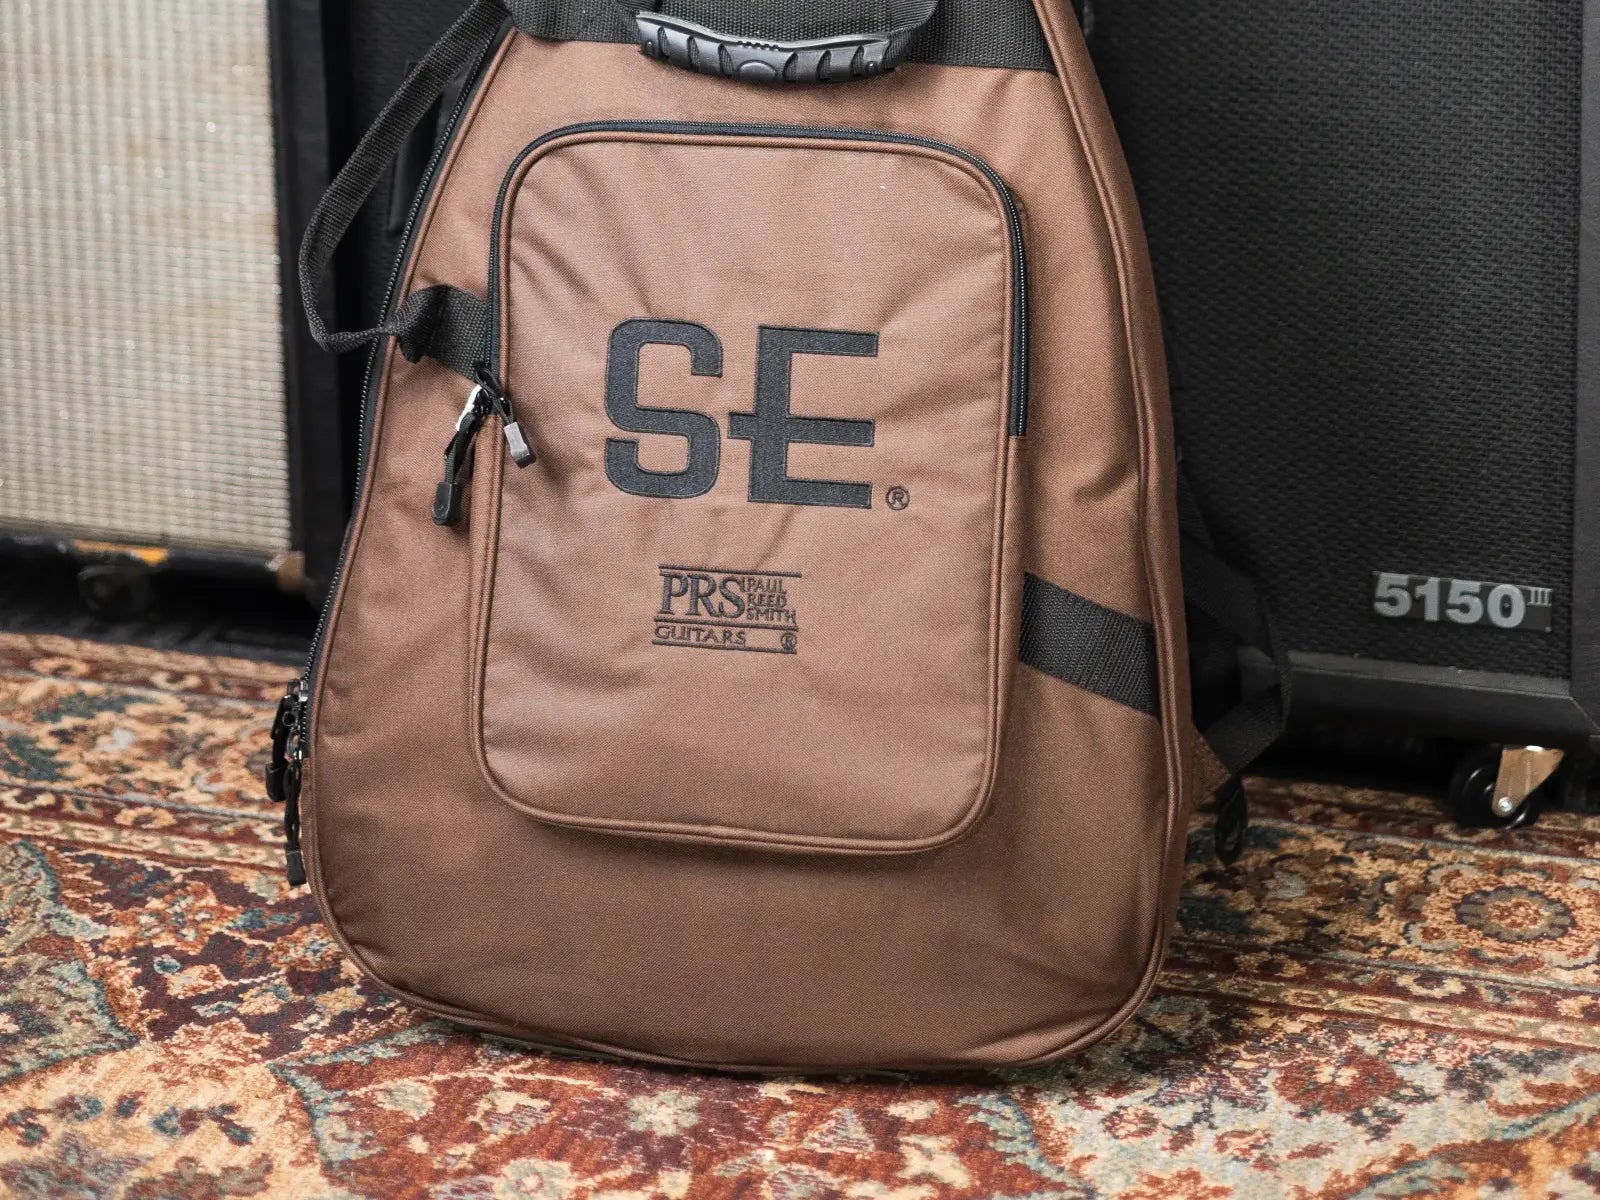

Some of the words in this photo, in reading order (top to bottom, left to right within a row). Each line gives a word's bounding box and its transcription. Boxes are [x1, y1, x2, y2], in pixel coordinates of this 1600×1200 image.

[604, 316, 879, 509] SE
[658, 572, 746, 619] PRS
[747, 592, 788, 608] REED
[654, 625, 746, 645] GUITARS
